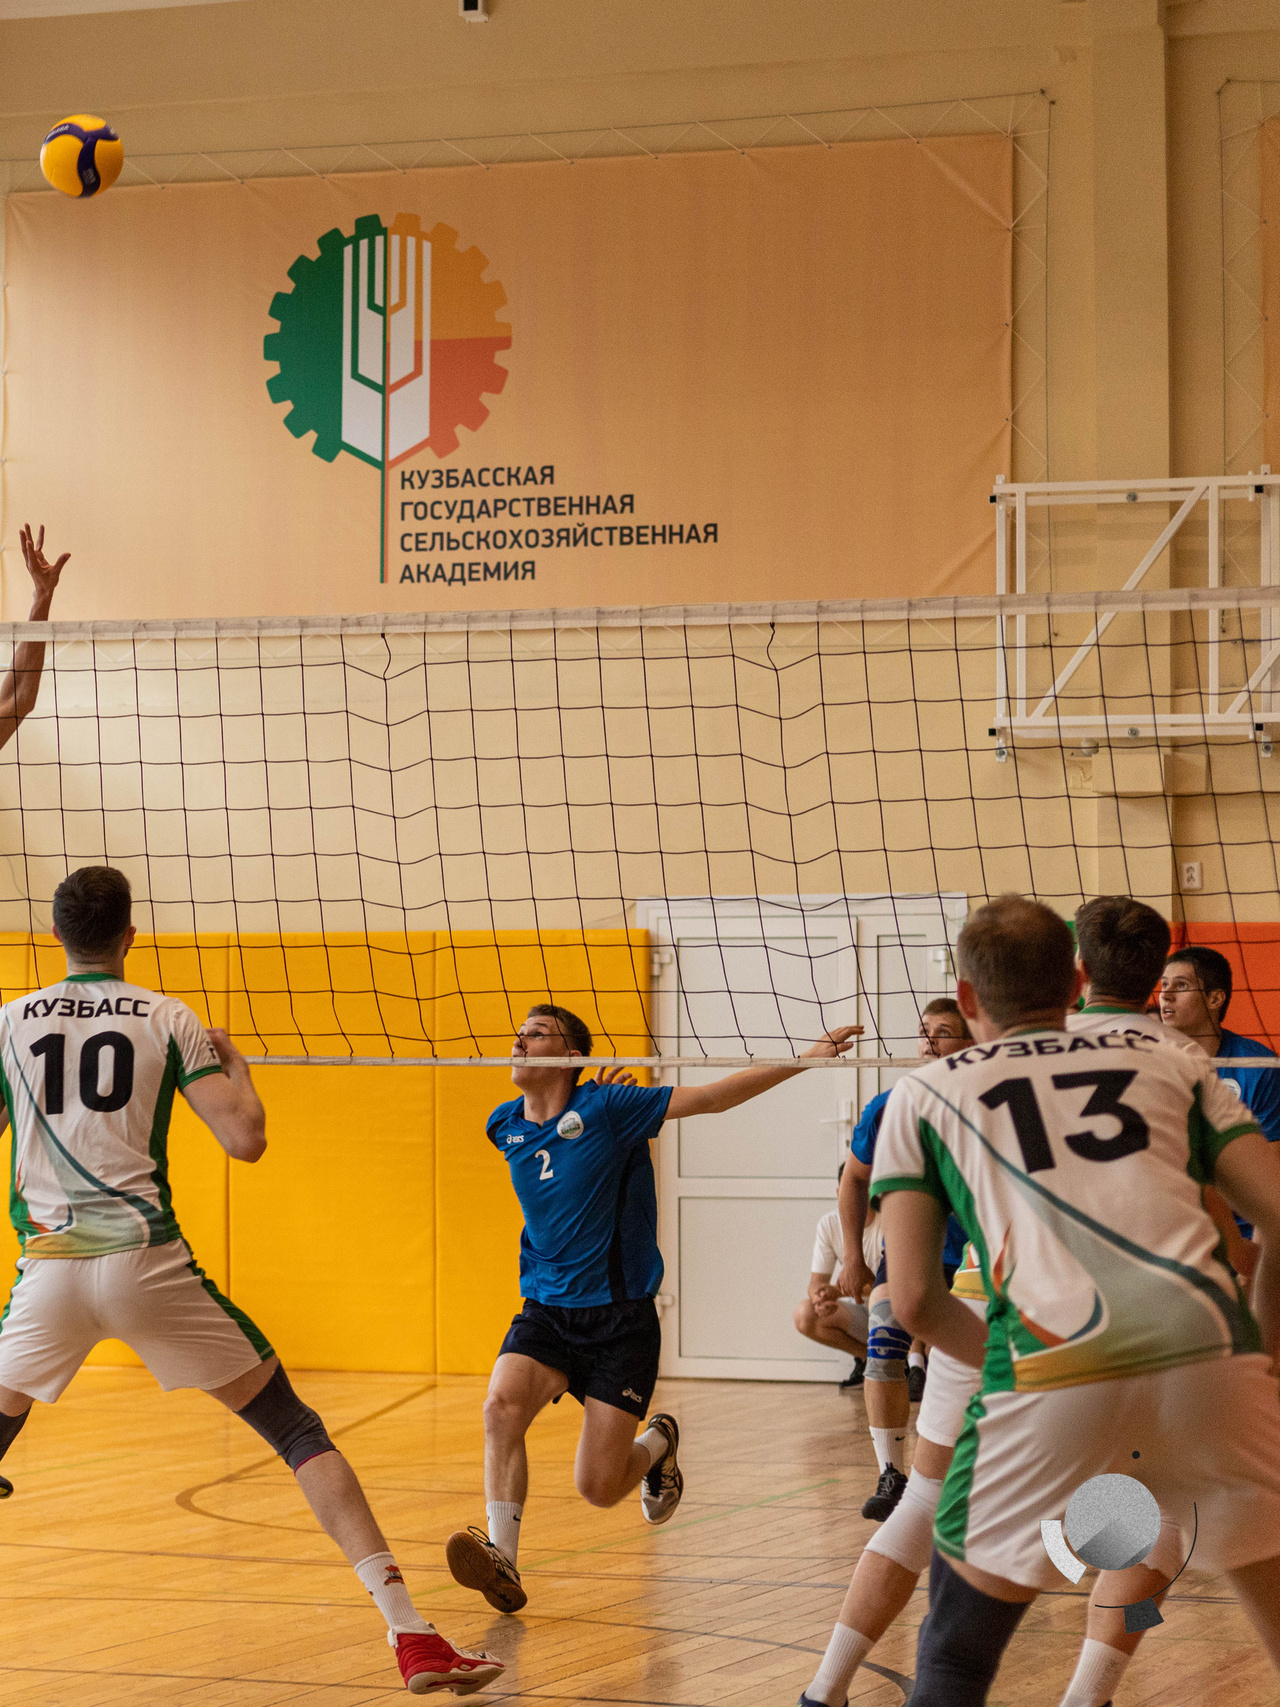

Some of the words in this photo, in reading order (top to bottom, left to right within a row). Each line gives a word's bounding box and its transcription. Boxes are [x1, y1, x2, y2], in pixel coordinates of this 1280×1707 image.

[400, 465, 556, 490] КУЗБАССКАЯ
[400, 494, 635, 523] ГОСУДАРСТВЕННАЯ
[399, 523, 719, 552] СЕЛЬСКОХОЗЯЙСТВЕННАЯ
[399, 560, 536, 586] АКАДЕМИЯ
[22, 997, 151, 1020] КУЗБАСС
[945, 1034, 1154, 1071] КУЗБАСС
[29, 1030, 135, 1115] 10
[977, 1069, 1151, 1174] 13
[534, 1149, 554, 1181] 2
